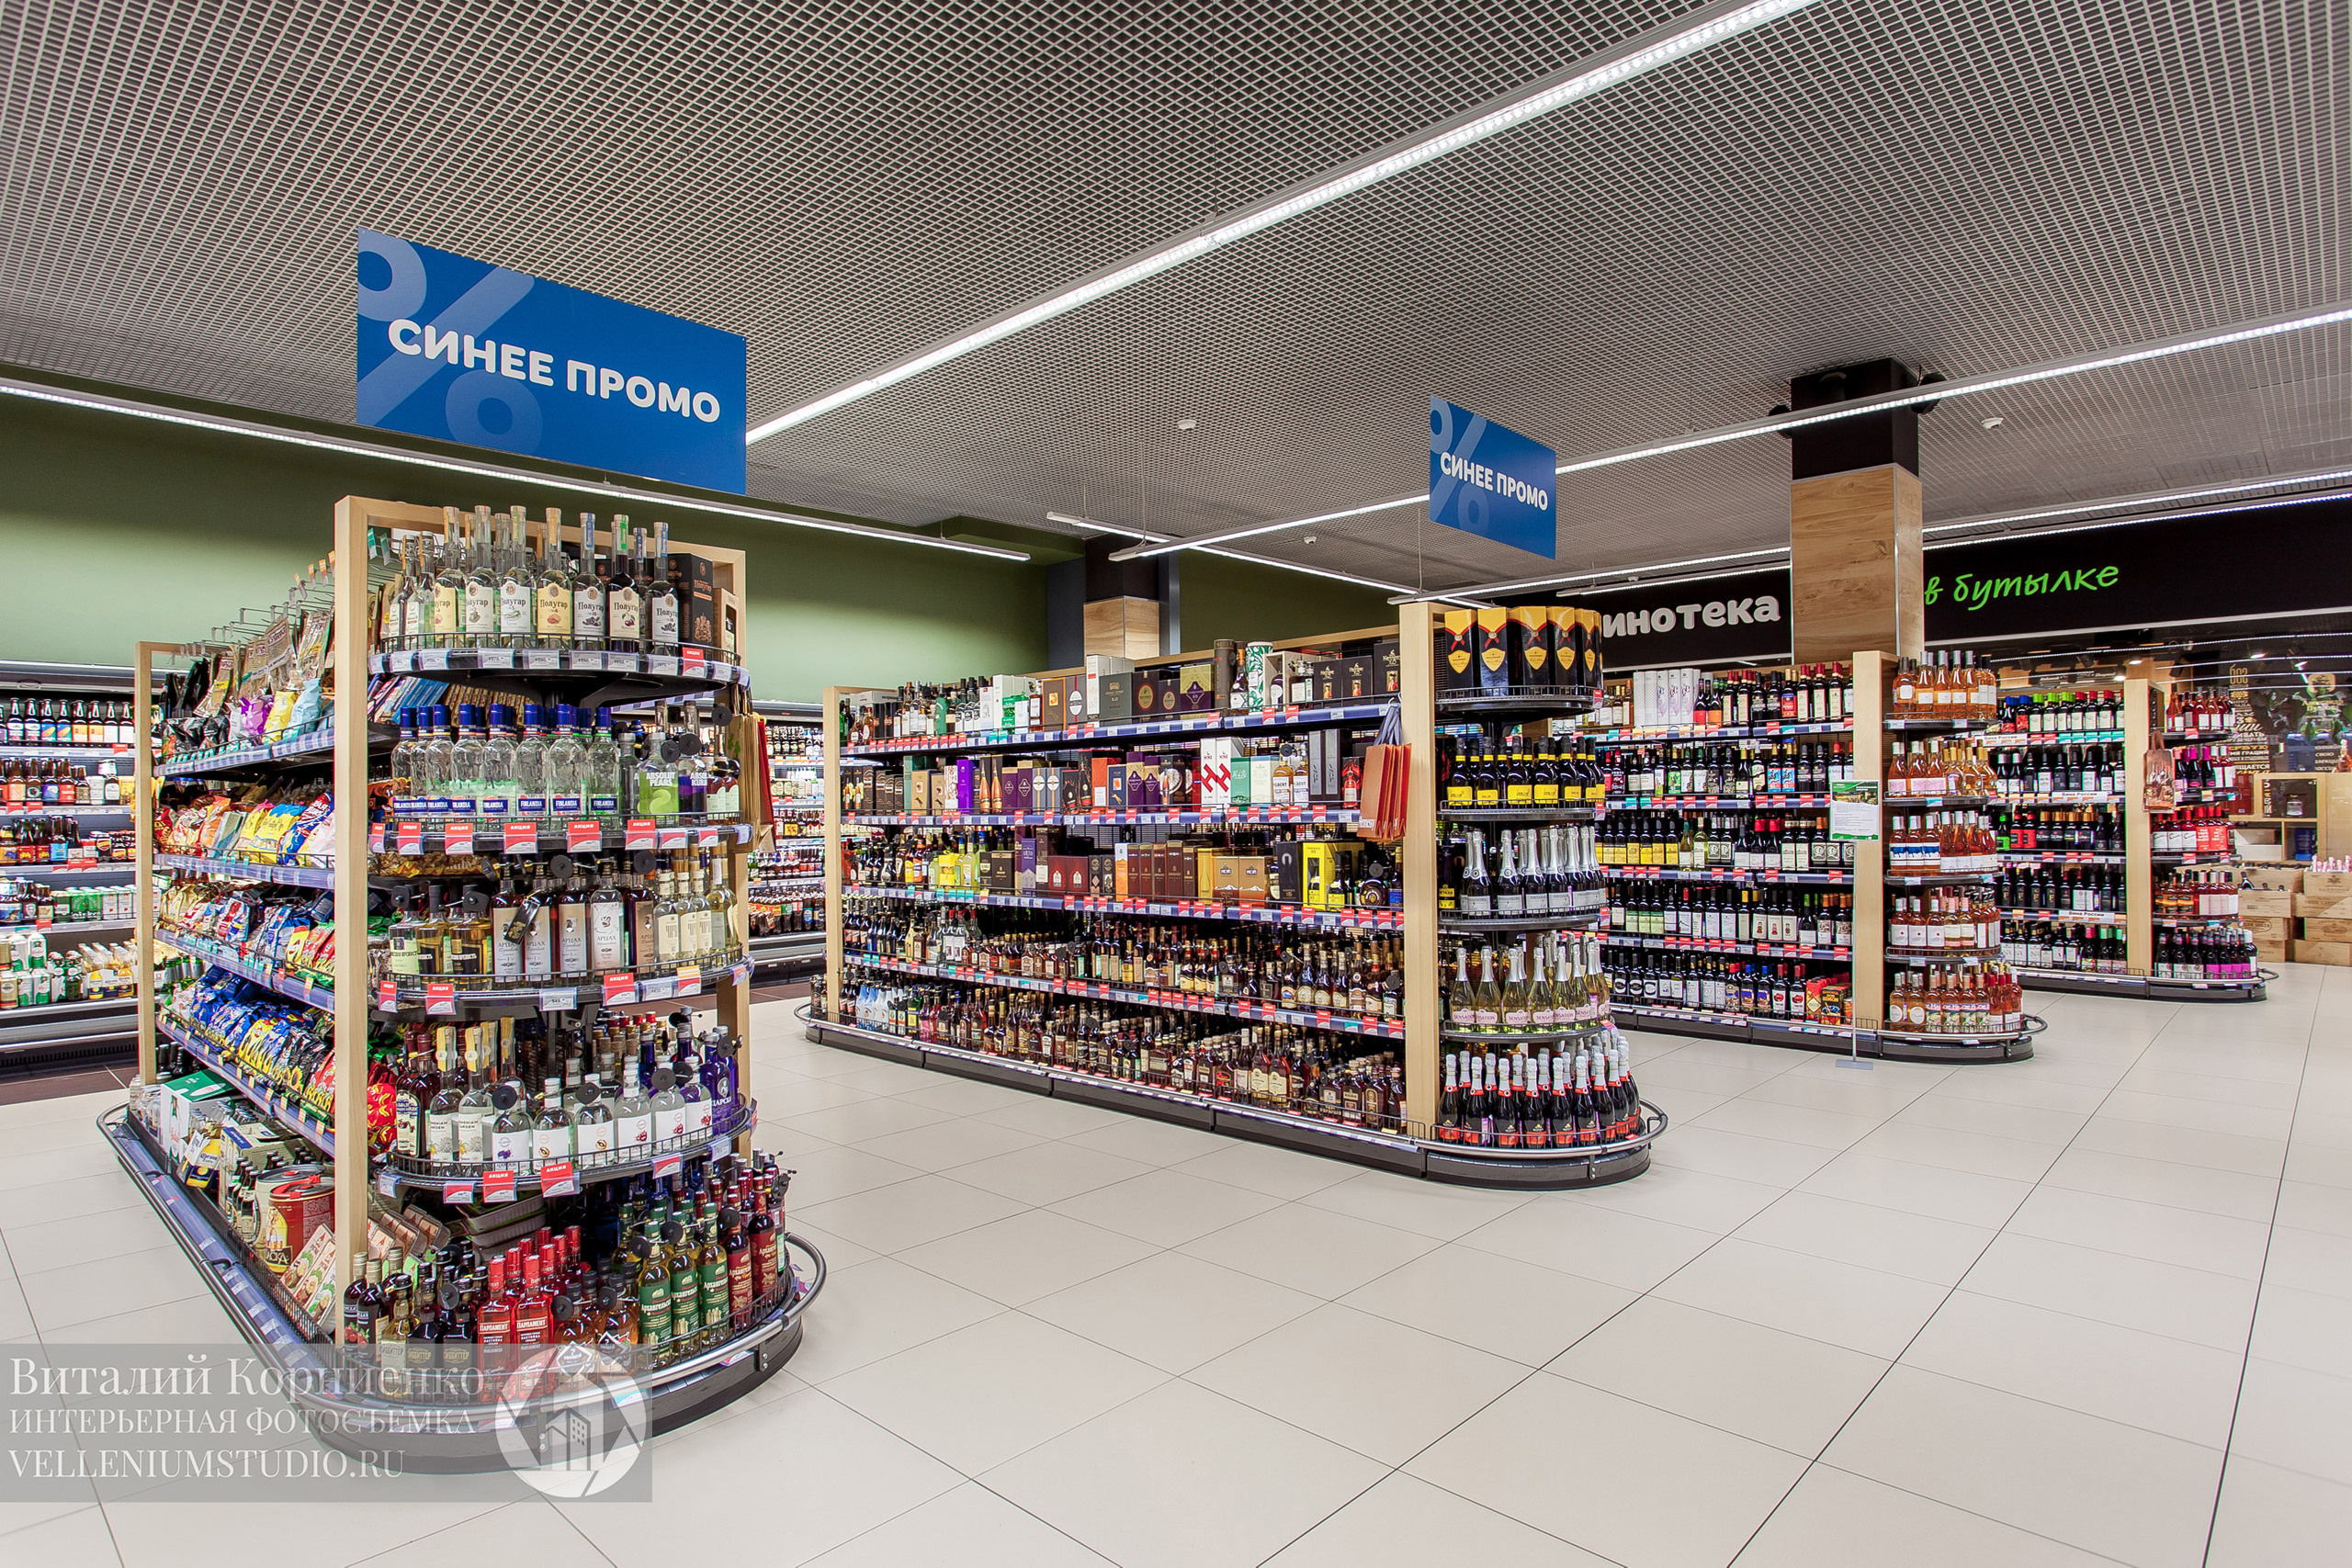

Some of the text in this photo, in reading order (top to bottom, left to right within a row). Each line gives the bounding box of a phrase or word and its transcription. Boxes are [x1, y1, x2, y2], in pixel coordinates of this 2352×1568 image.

[389, 318, 720, 423] СИНЕЕ ПРОМО
[1440, 451, 1548, 511] СИНЕЕ ПРОМО
[1924, 566, 2119, 611] в бутылке
[540, 599, 568, 609] Полугар
[578, 602, 604, 613] Полугар
[1602, 595, 1781, 637] инотека
[646, 772, 675, 780] ABSOLUT
[546, 1165, 566, 1173] АКЦИЯ
[480, 1323, 508, 1332] ПАРЛАМЕНТ
[517, 1319, 546, 1329] ПАРЛАМЕНТ
